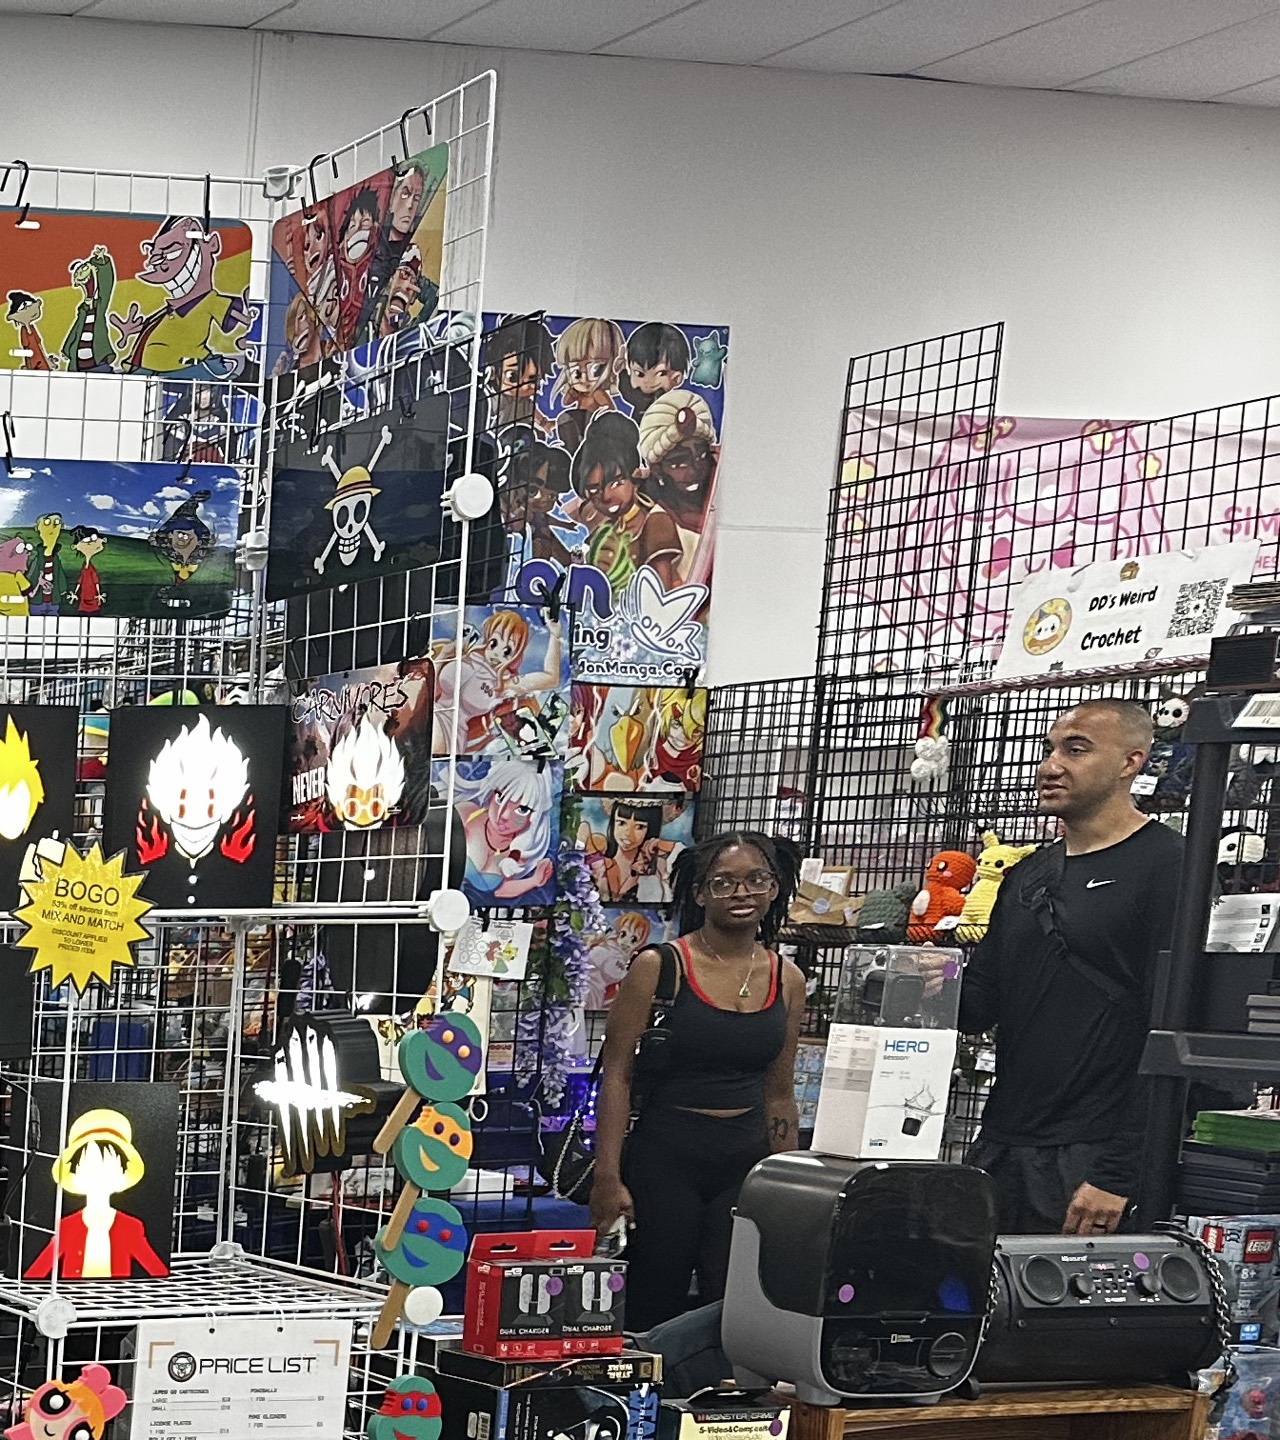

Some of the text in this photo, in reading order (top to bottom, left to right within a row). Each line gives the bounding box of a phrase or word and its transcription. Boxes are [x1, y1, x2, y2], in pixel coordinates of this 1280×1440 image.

[1089, 586, 1159, 612] DD's Weird
[1081, 625, 1142, 651] Crochet
[54, 878, 120, 906] BOGO
[42, 909, 125, 931] MIX AND MATCH
[884, 1040, 930, 1053] HERO
[1246, 1240, 1272, 1254] LEGO
[1241, 1268, 1256, 1280] 8+
[199, 1355, 317, 1375] PRICE LIST
